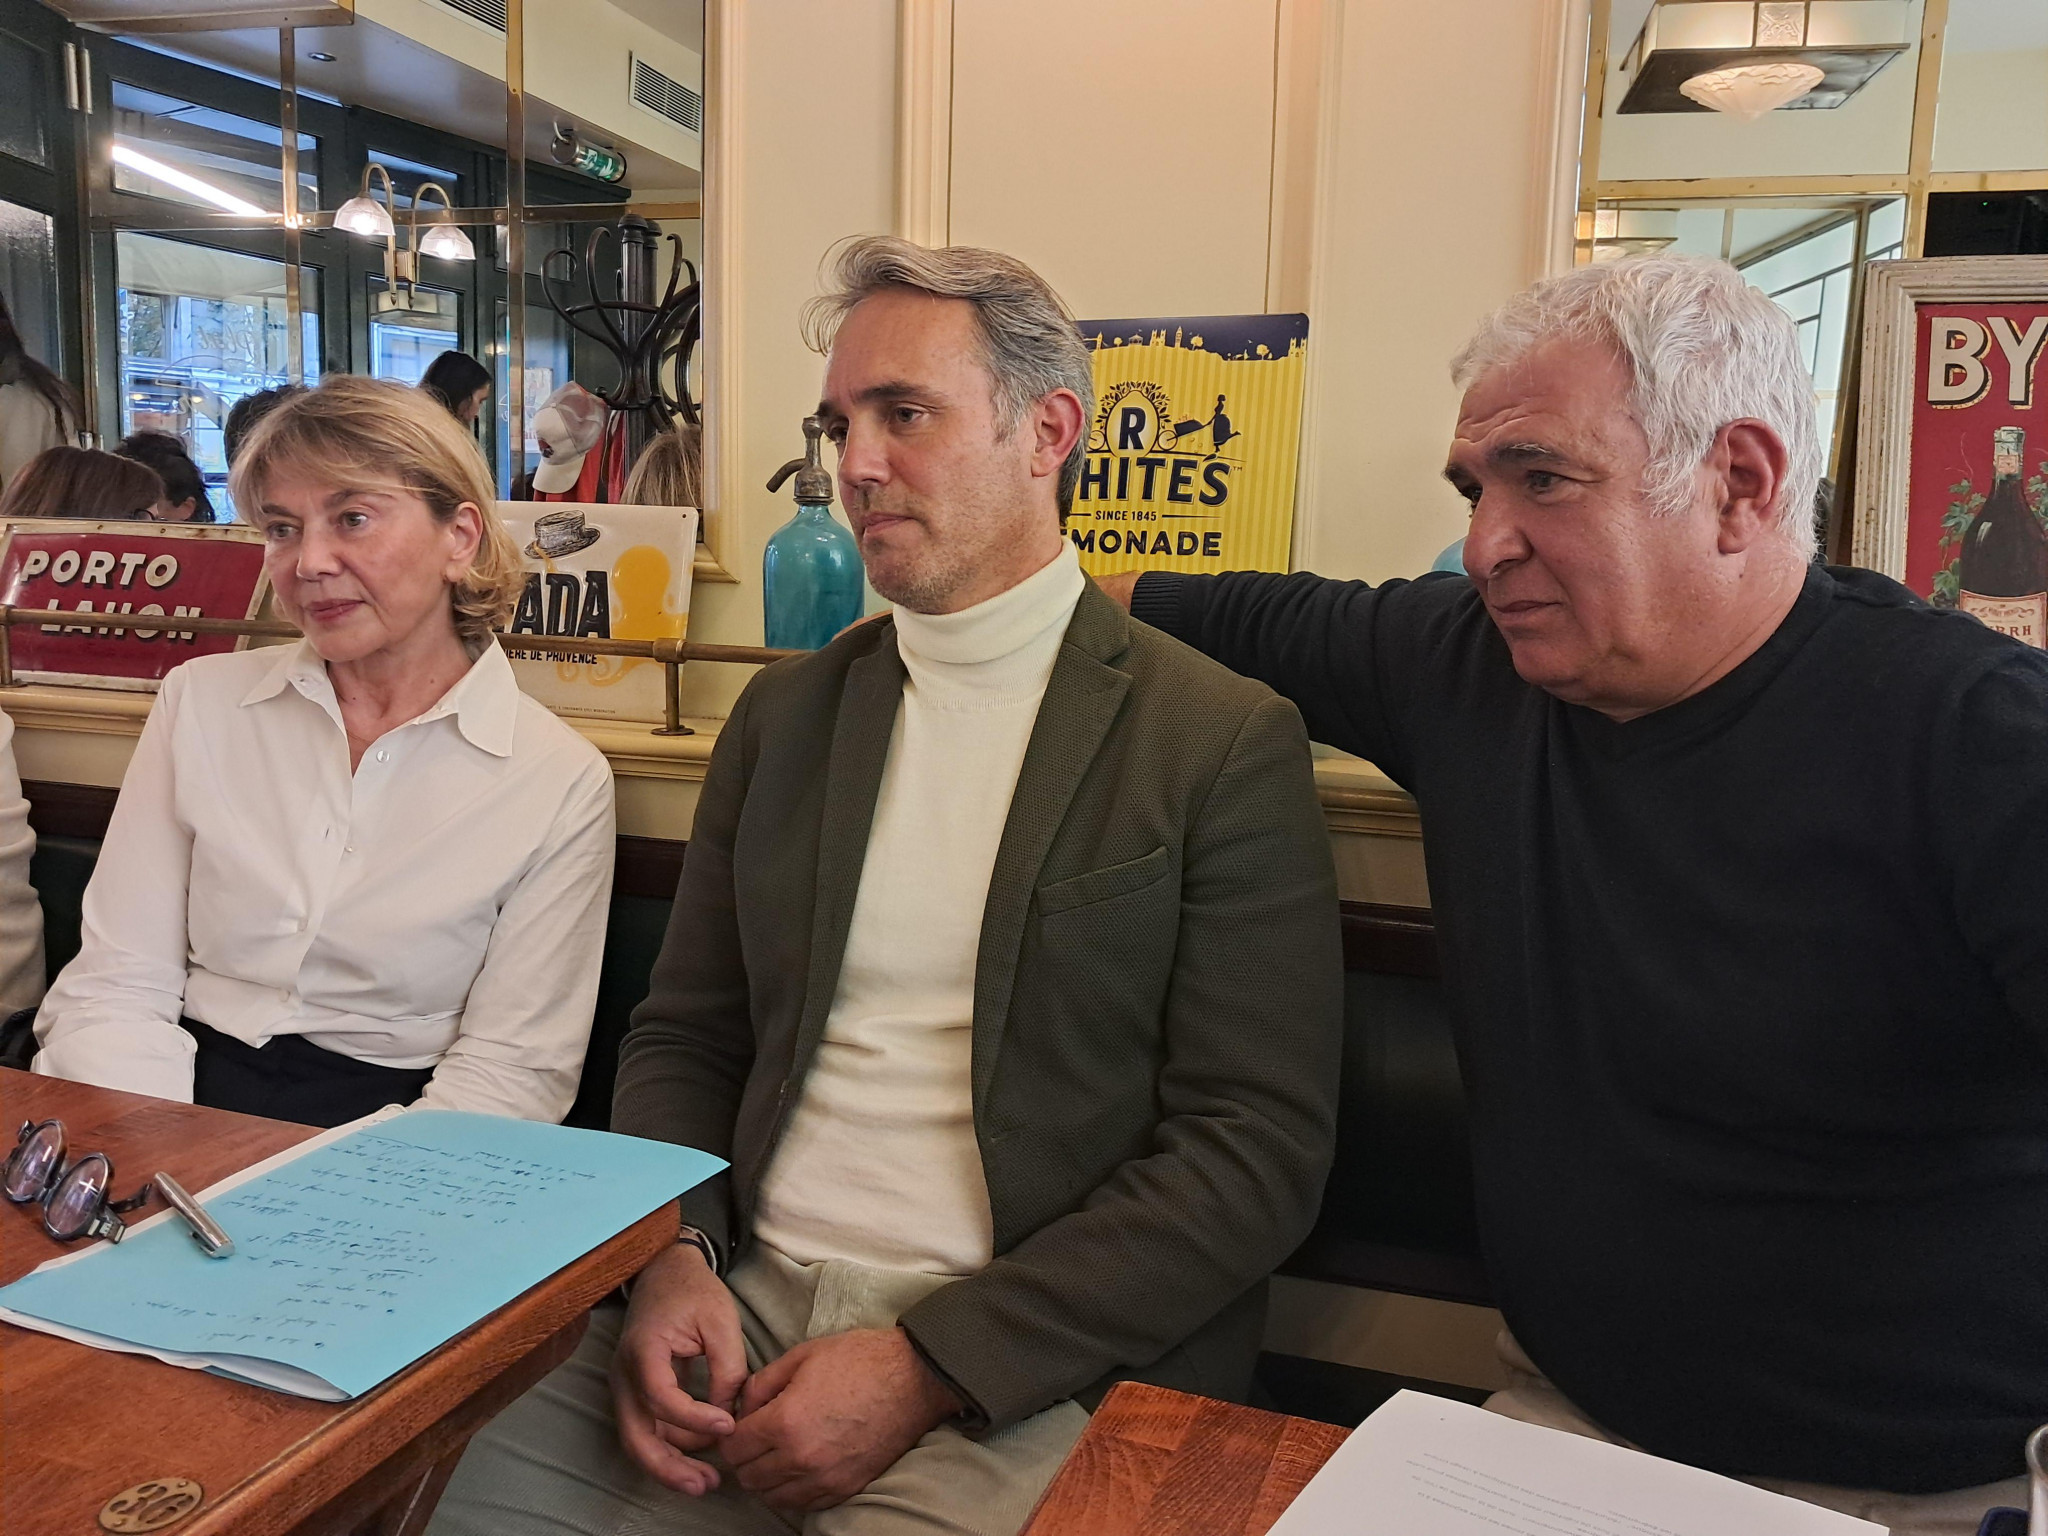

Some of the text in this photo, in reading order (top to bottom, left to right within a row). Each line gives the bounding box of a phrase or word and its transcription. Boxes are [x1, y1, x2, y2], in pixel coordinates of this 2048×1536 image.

[1928, 316, 2048, 407] BY
[1118, 406, 1147, 450] R
[1095, 510, 1157, 521] SINCE 1845
[1060, 528, 1222, 557] MONADE
[20, 549, 179, 588] PORTO
[494, 570, 611, 639] ADA
[1989, 625, 2031, 637] RRH
[530, 650, 543, 661] DE
[546, 651, 598, 665] PROVENCE
